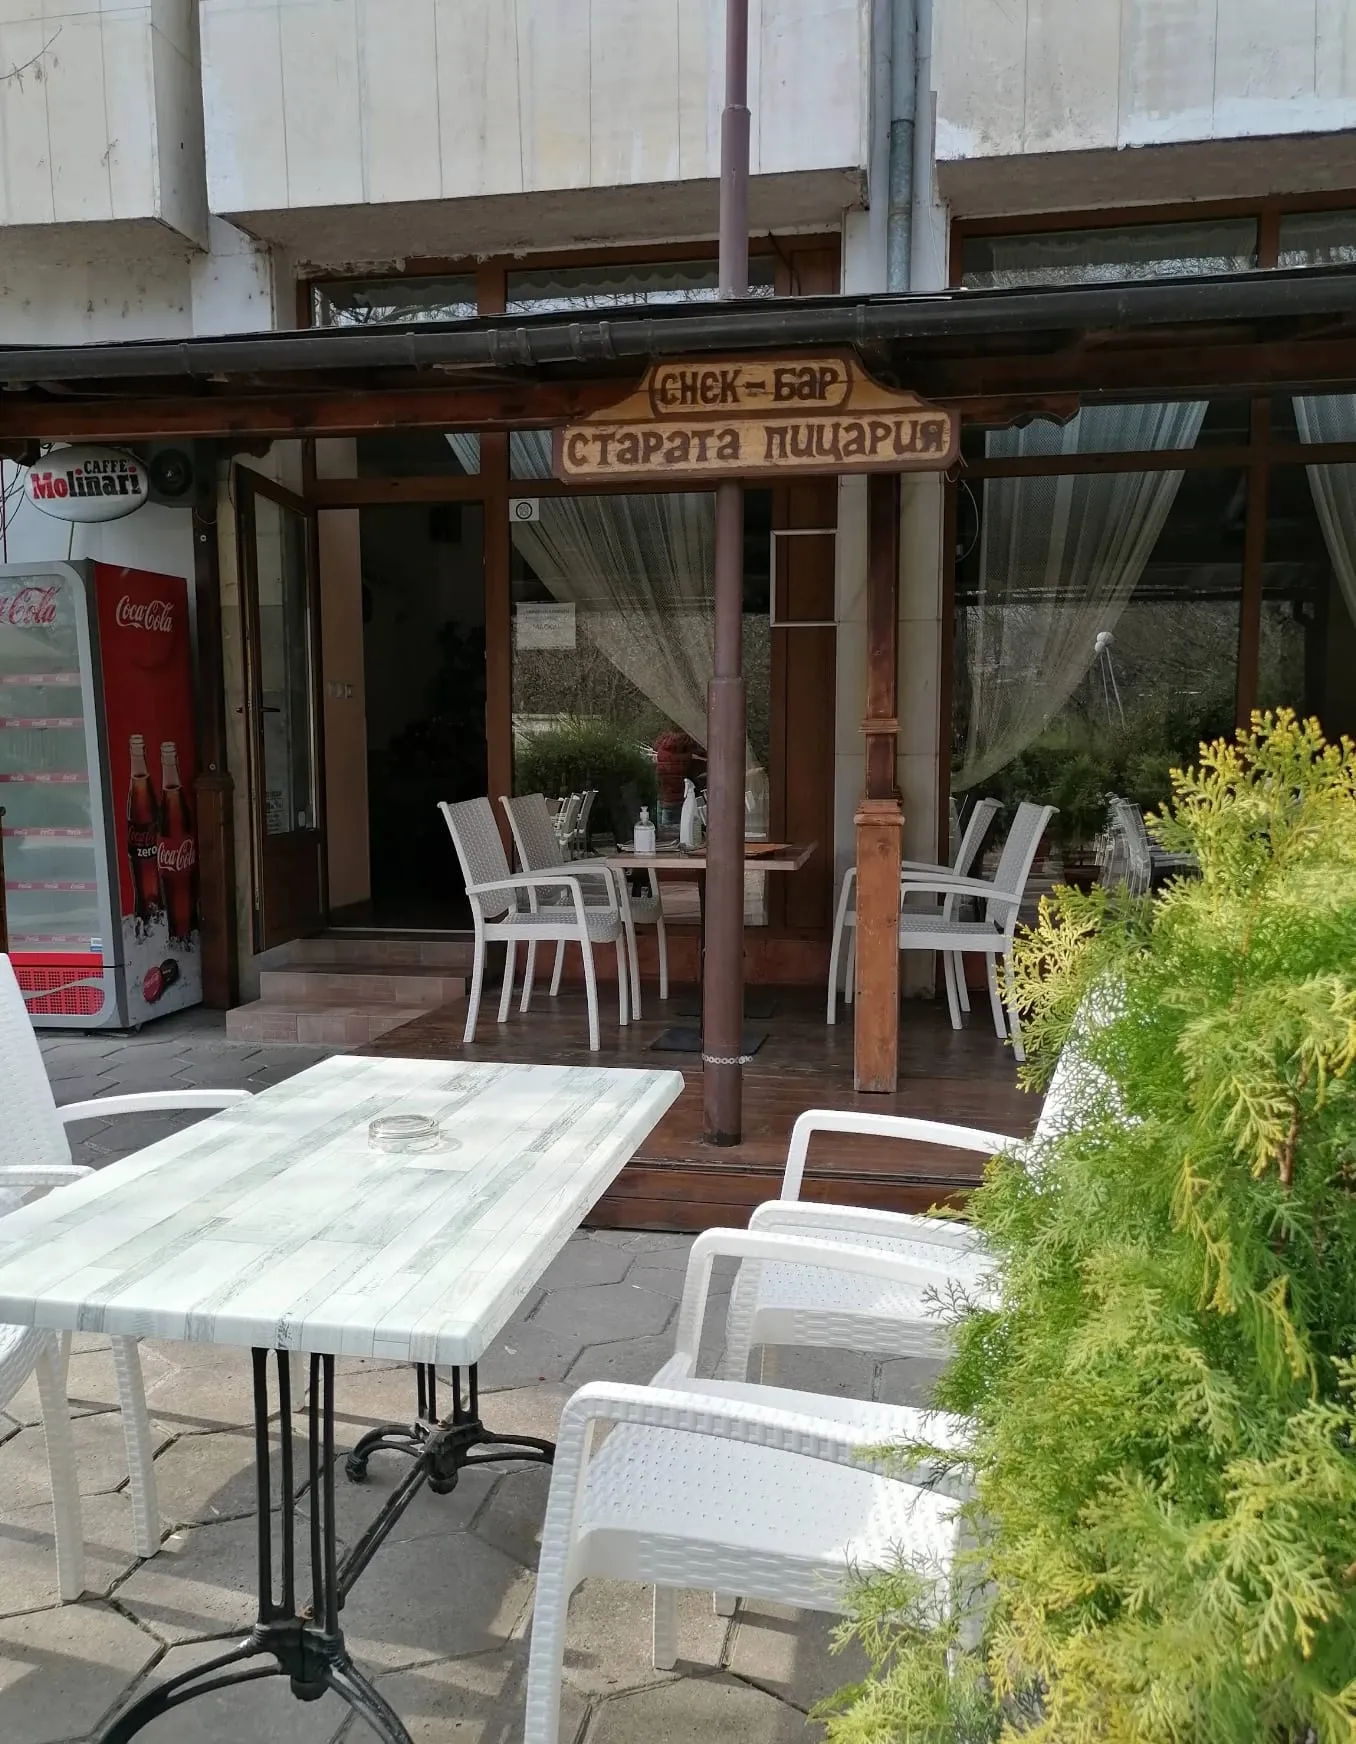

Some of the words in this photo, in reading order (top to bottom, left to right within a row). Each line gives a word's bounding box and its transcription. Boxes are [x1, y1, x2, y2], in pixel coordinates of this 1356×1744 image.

[567, 428, 740, 467] СТАРАТА
[763, 419, 945, 461] ПИЦАРИЯ
[31, 465, 142, 499] Molinari
[116, 595, 175, 632] Coca-Cola
[137, 845, 158, 857] zero
